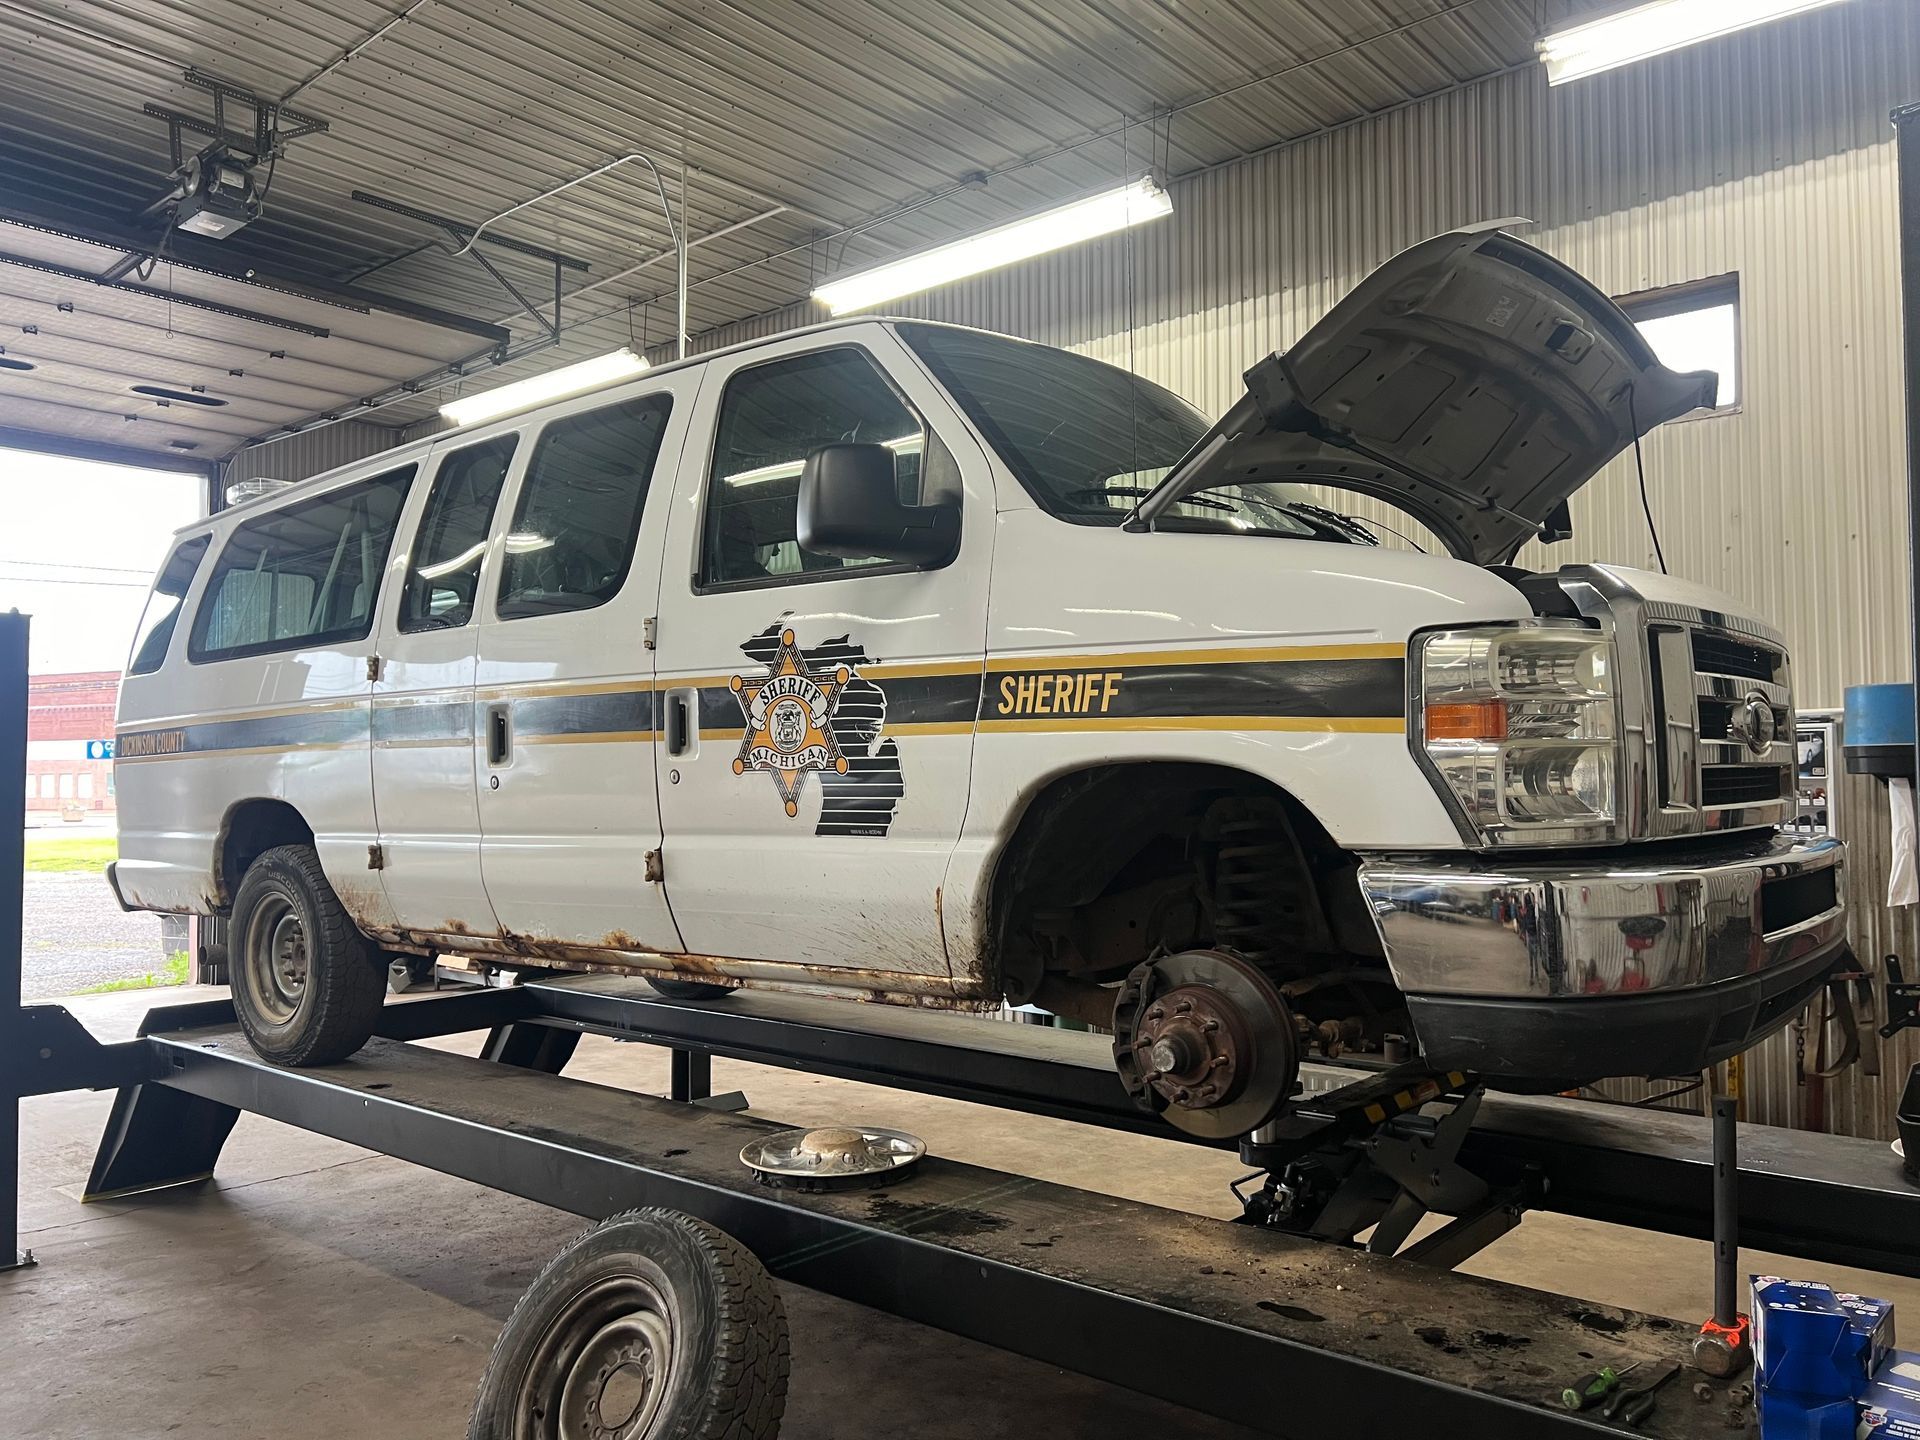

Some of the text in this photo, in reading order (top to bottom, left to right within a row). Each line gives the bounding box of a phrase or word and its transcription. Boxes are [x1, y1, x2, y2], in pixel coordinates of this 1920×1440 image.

[760, 677, 821, 707] SHERIFF
[997, 672, 1123, 715] SHERIFF
[121, 731, 185, 756] DICKINSON COUNTY
[751, 747, 828, 768] MICHIGAN
